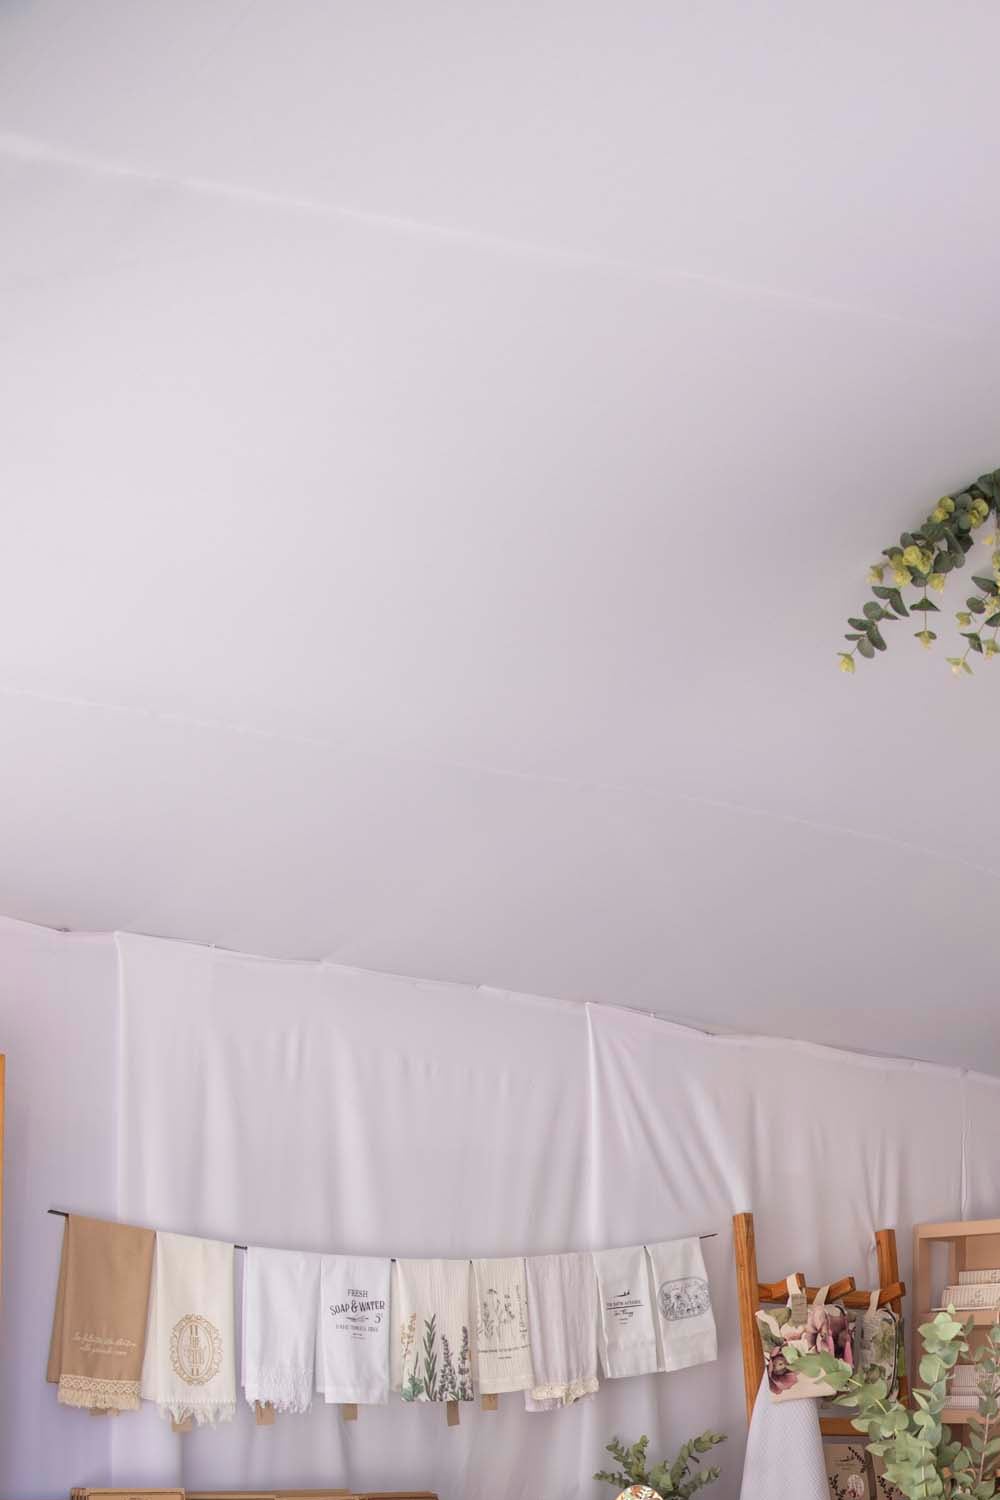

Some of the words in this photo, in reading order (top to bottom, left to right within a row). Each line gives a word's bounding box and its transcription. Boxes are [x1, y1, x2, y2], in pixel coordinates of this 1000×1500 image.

[347, 1288, 368, 1298] FRESH
[329, 1303, 350, 1316] SOAP
[350, 1299, 359, 1313] &
[358, 1300, 385, 1312] WATER
